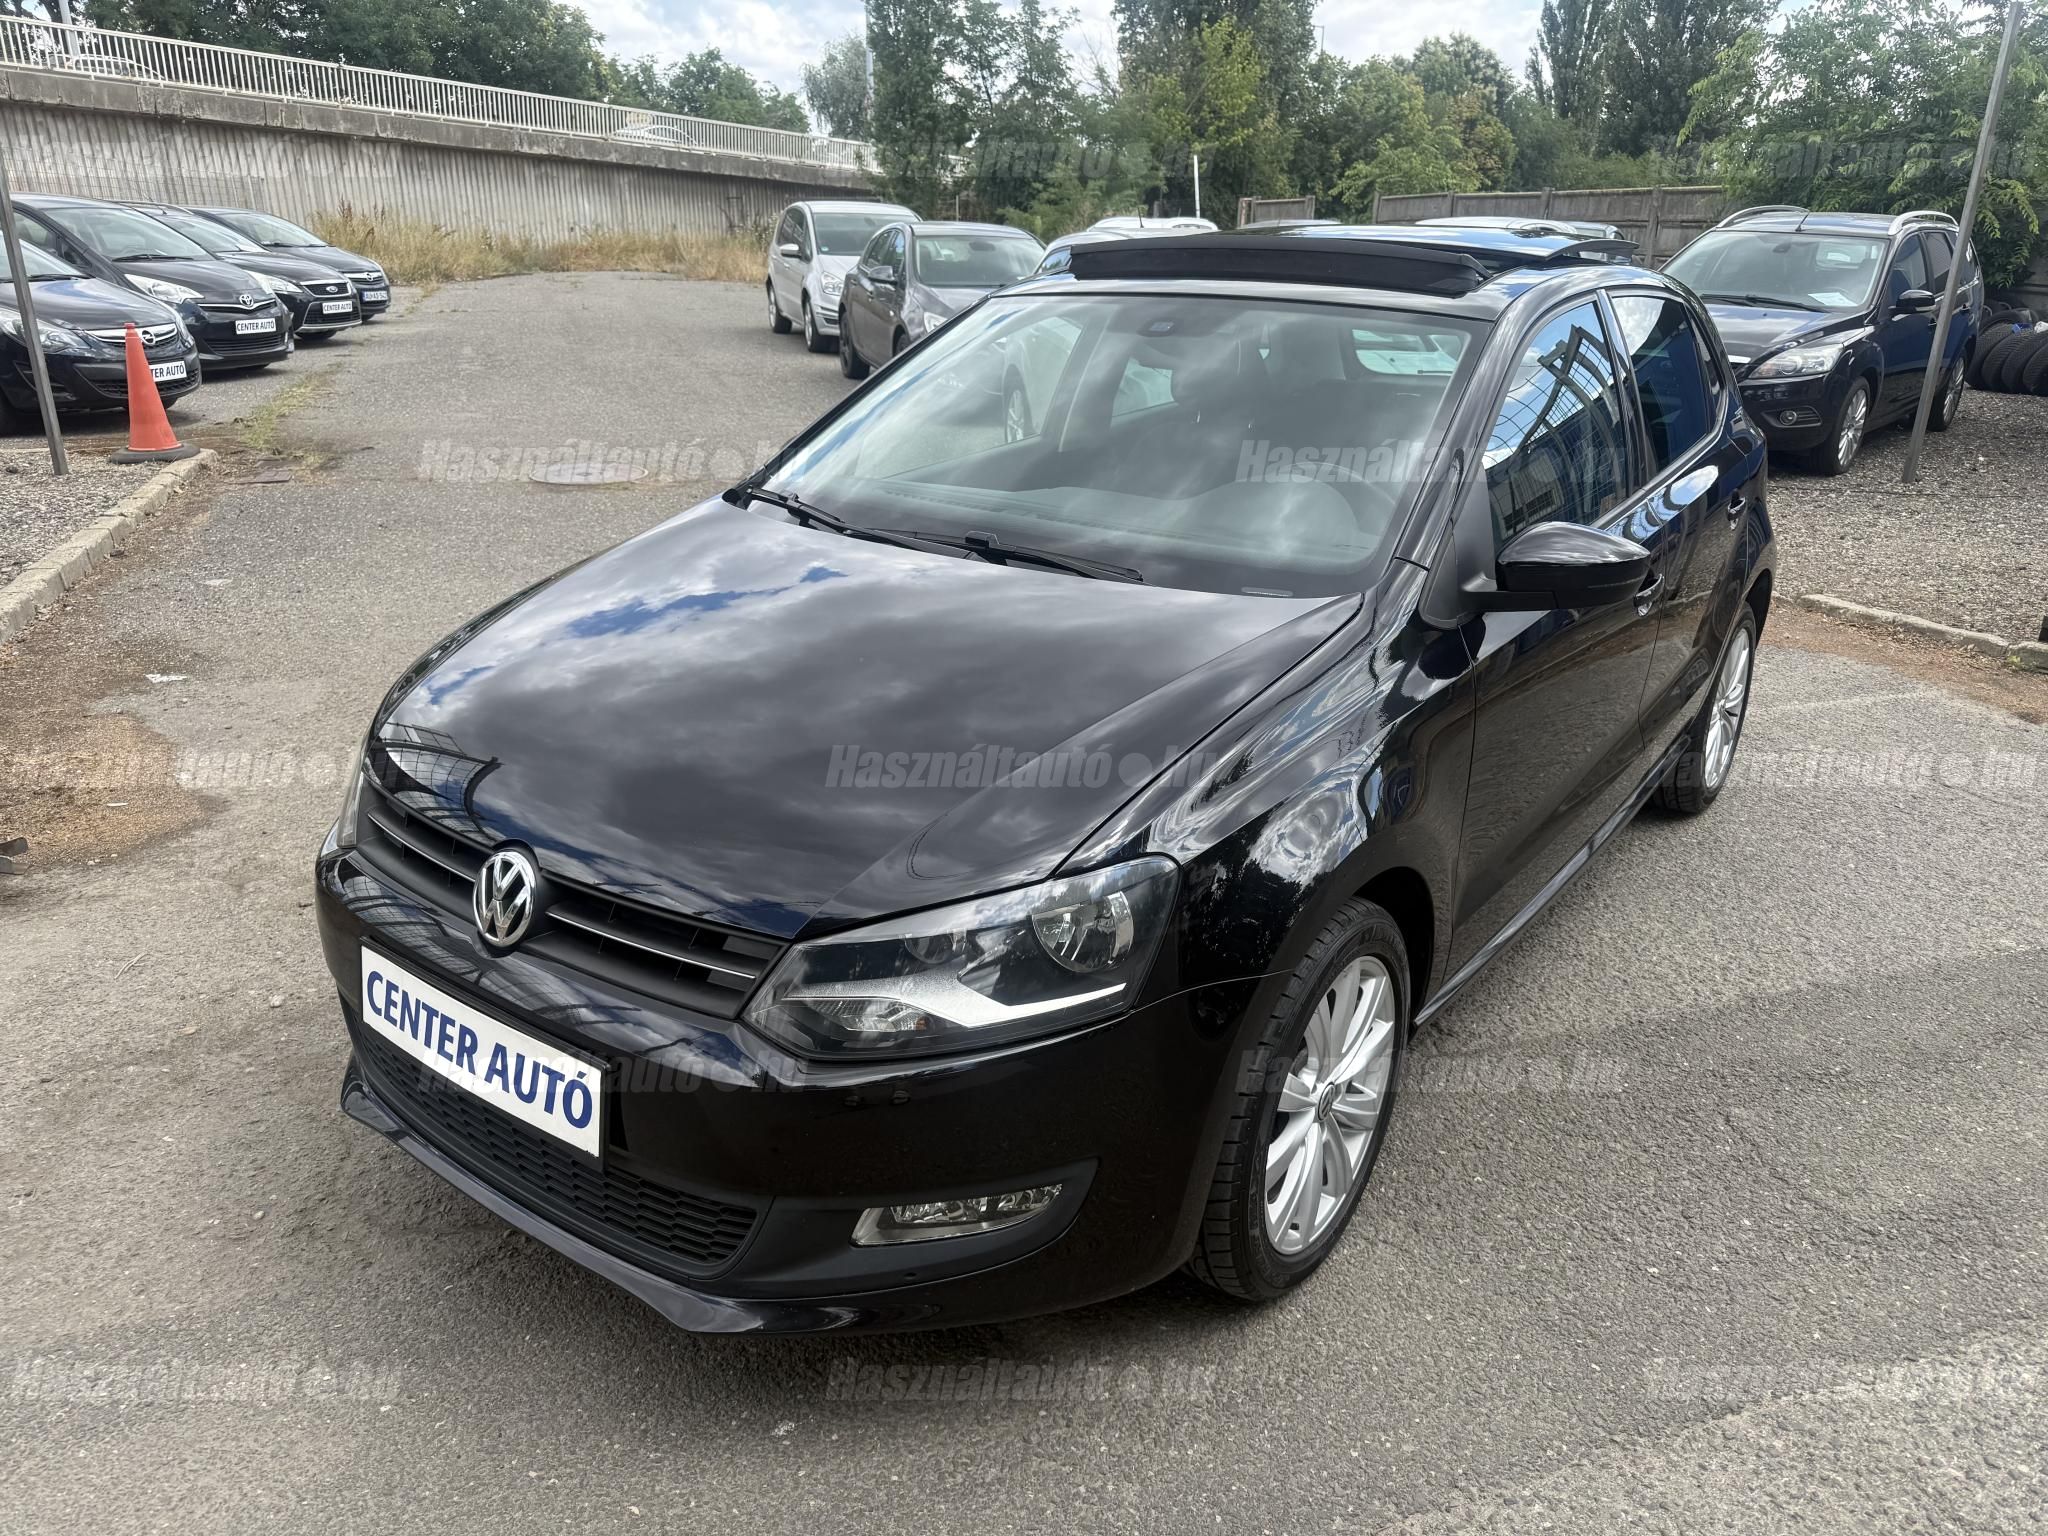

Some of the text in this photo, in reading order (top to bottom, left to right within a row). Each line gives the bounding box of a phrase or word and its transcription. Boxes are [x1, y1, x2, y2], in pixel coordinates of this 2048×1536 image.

[236, 322, 259, 331] CENTER
[166, 363, 185, 377] AUTÓ
[367, 971, 593, 1129] CENTER AUTÓ
